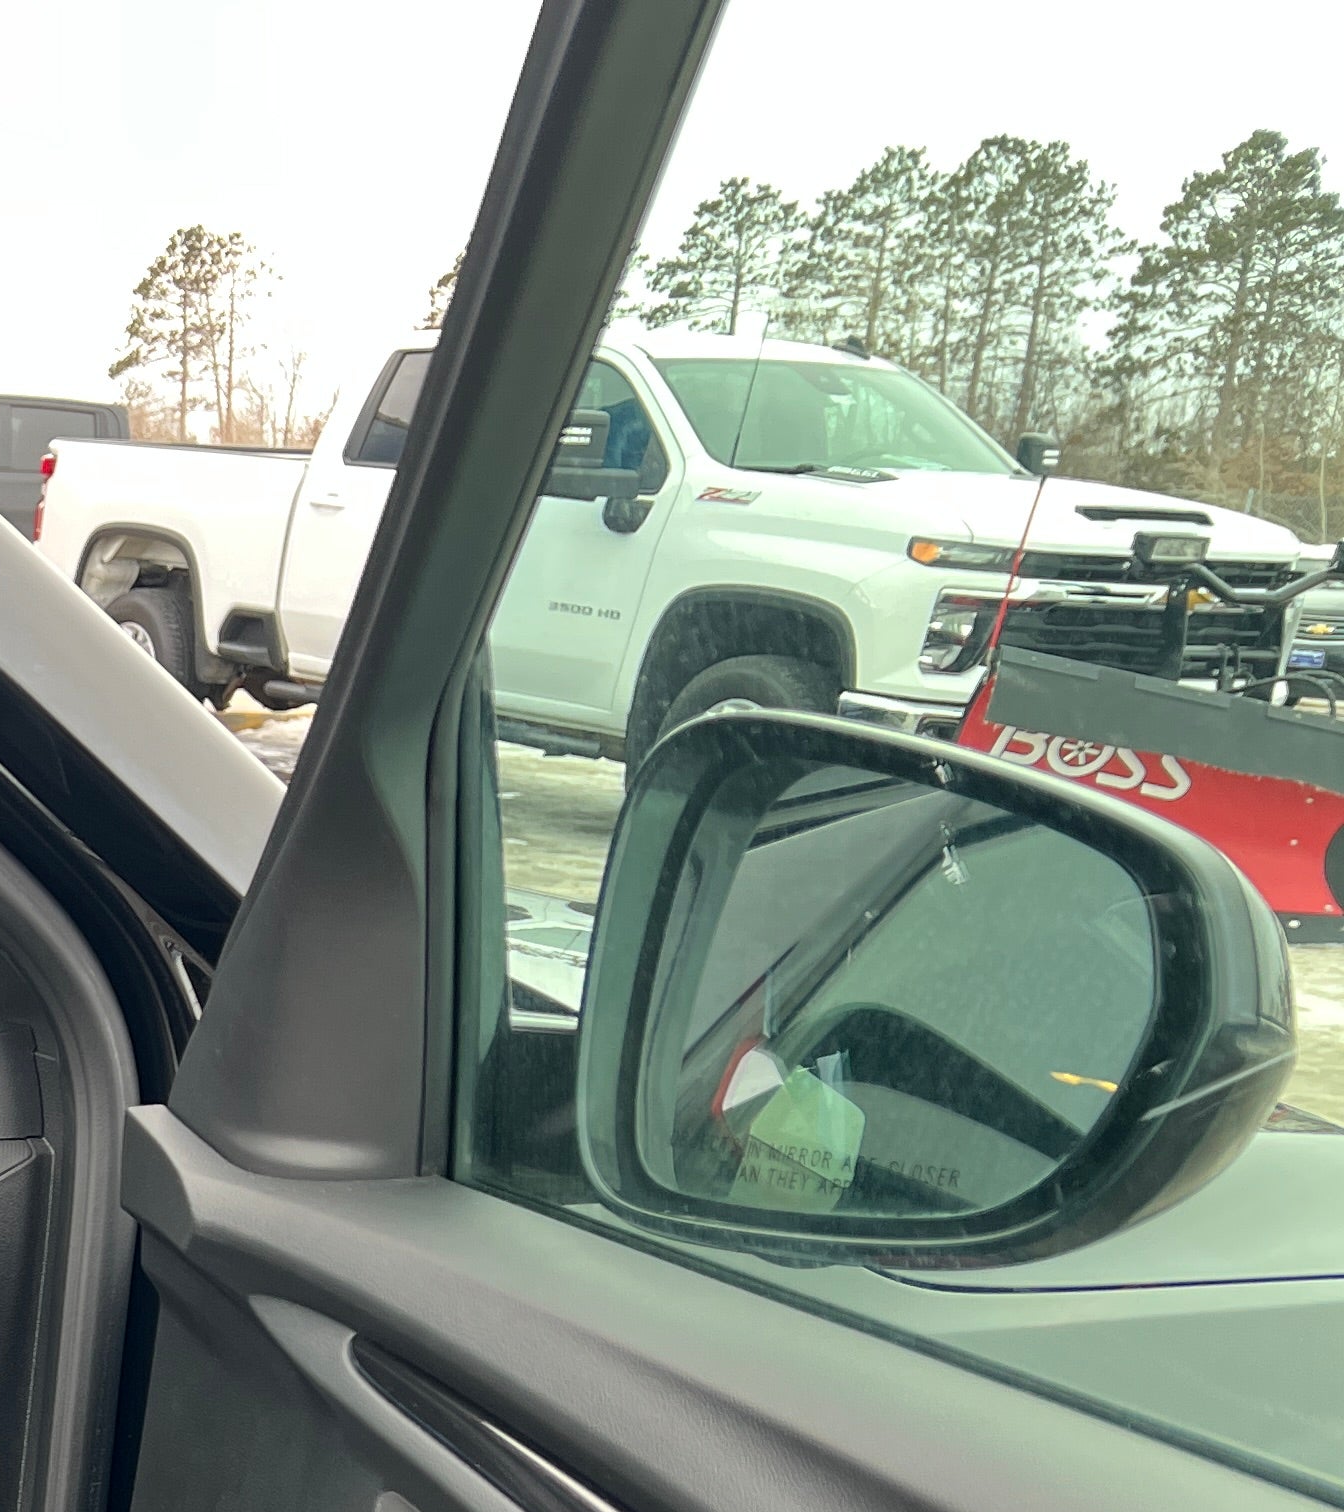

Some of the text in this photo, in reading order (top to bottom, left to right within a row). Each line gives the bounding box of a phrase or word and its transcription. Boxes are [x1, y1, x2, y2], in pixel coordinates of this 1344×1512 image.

[548, 602, 621, 621] 3500 HD
[768, 1143, 833, 1170] MIRROR
[767, 1166, 811, 1191] THEY
